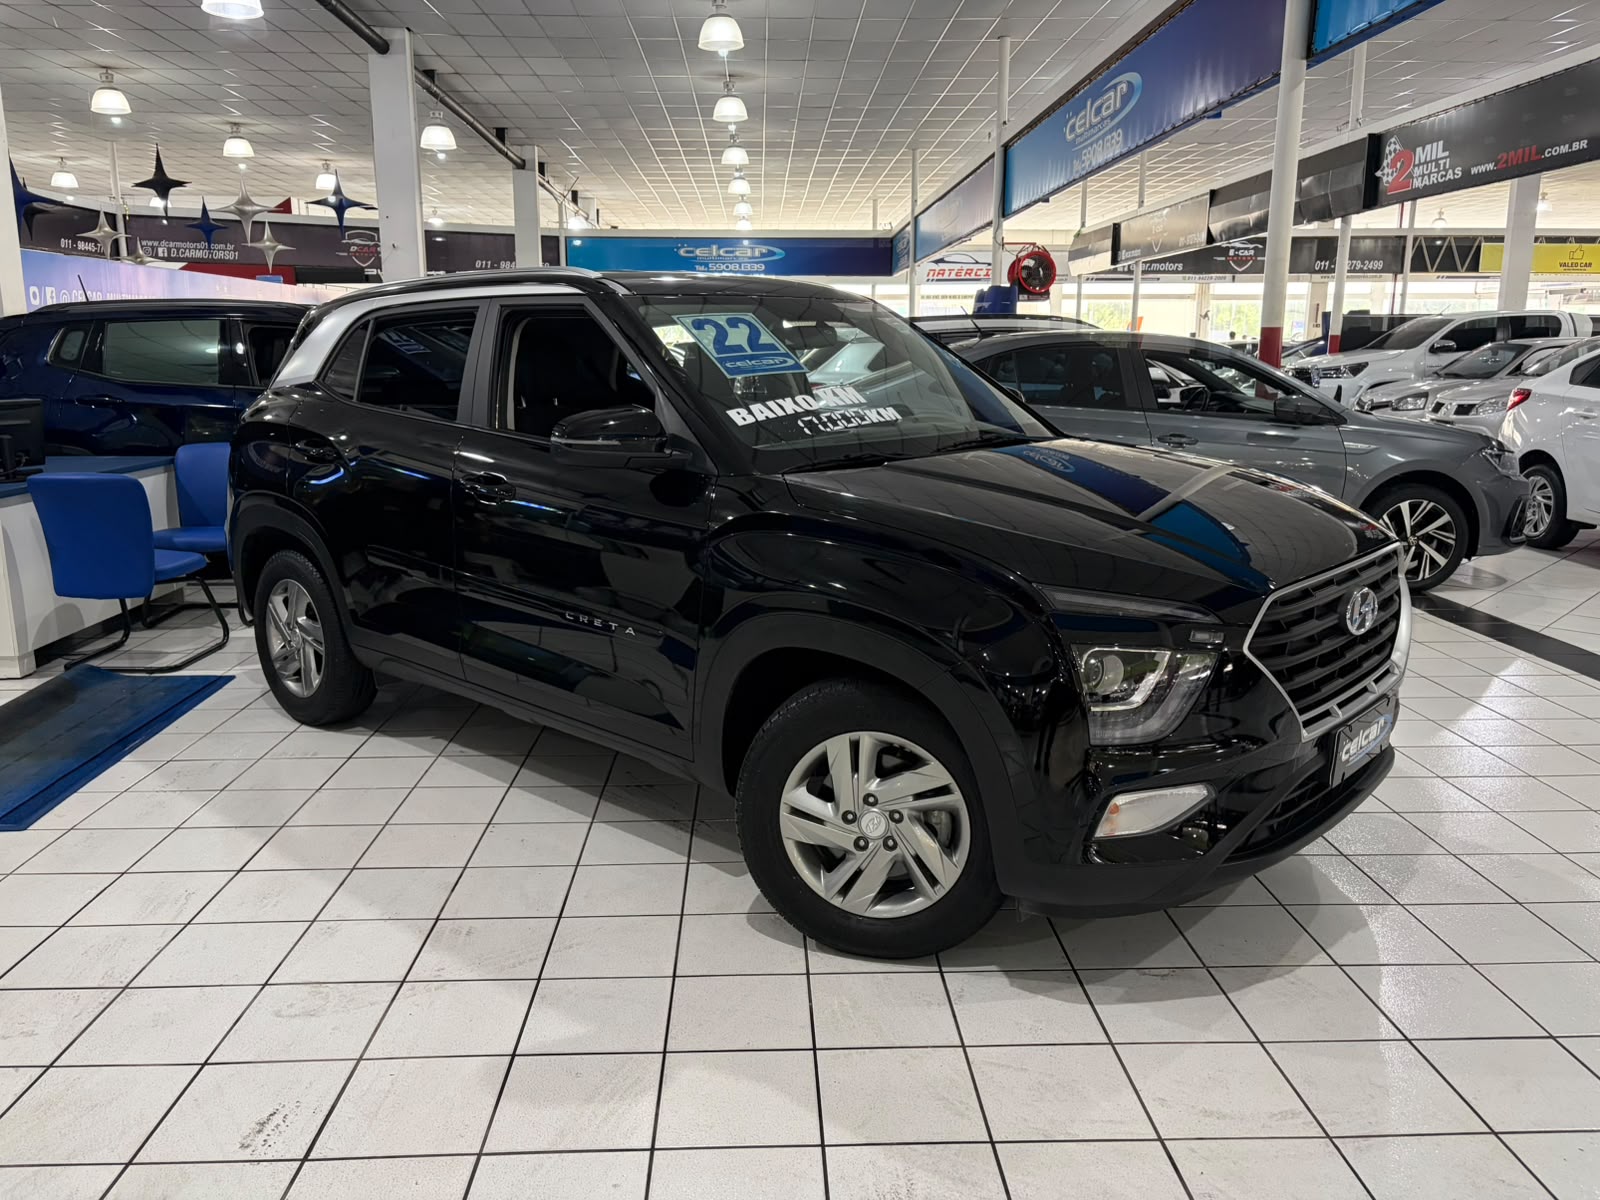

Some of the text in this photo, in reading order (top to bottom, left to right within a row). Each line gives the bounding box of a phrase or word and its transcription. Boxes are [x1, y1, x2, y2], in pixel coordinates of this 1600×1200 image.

[1065, 80, 1128, 142] celcar
[1387, 140, 1450, 195] 2 MIL
[1413, 158, 1450, 177] MULTI
[1412, 166, 1462, 190] MARCAS
[60, 238, 72, 248] 011
[141, 239, 235, 250] www.dcarmotors01com.br
[677, 244, 768, 258] celcar
[475, 259, 492, 269] 011
[926, 266, 993, 278] NATÉRCI
[1129, 261, 1184, 272] ear.motors
[1314, 260, 1330, 271] 011
[1347, 260, 1384, 270] 279-2499
[691, 316, 786, 356] 22
[726, 386, 868, 427] BAIXO KM
[565, 610, 636, 636] CRETA
[1341, 717, 1385, 763] celcar
